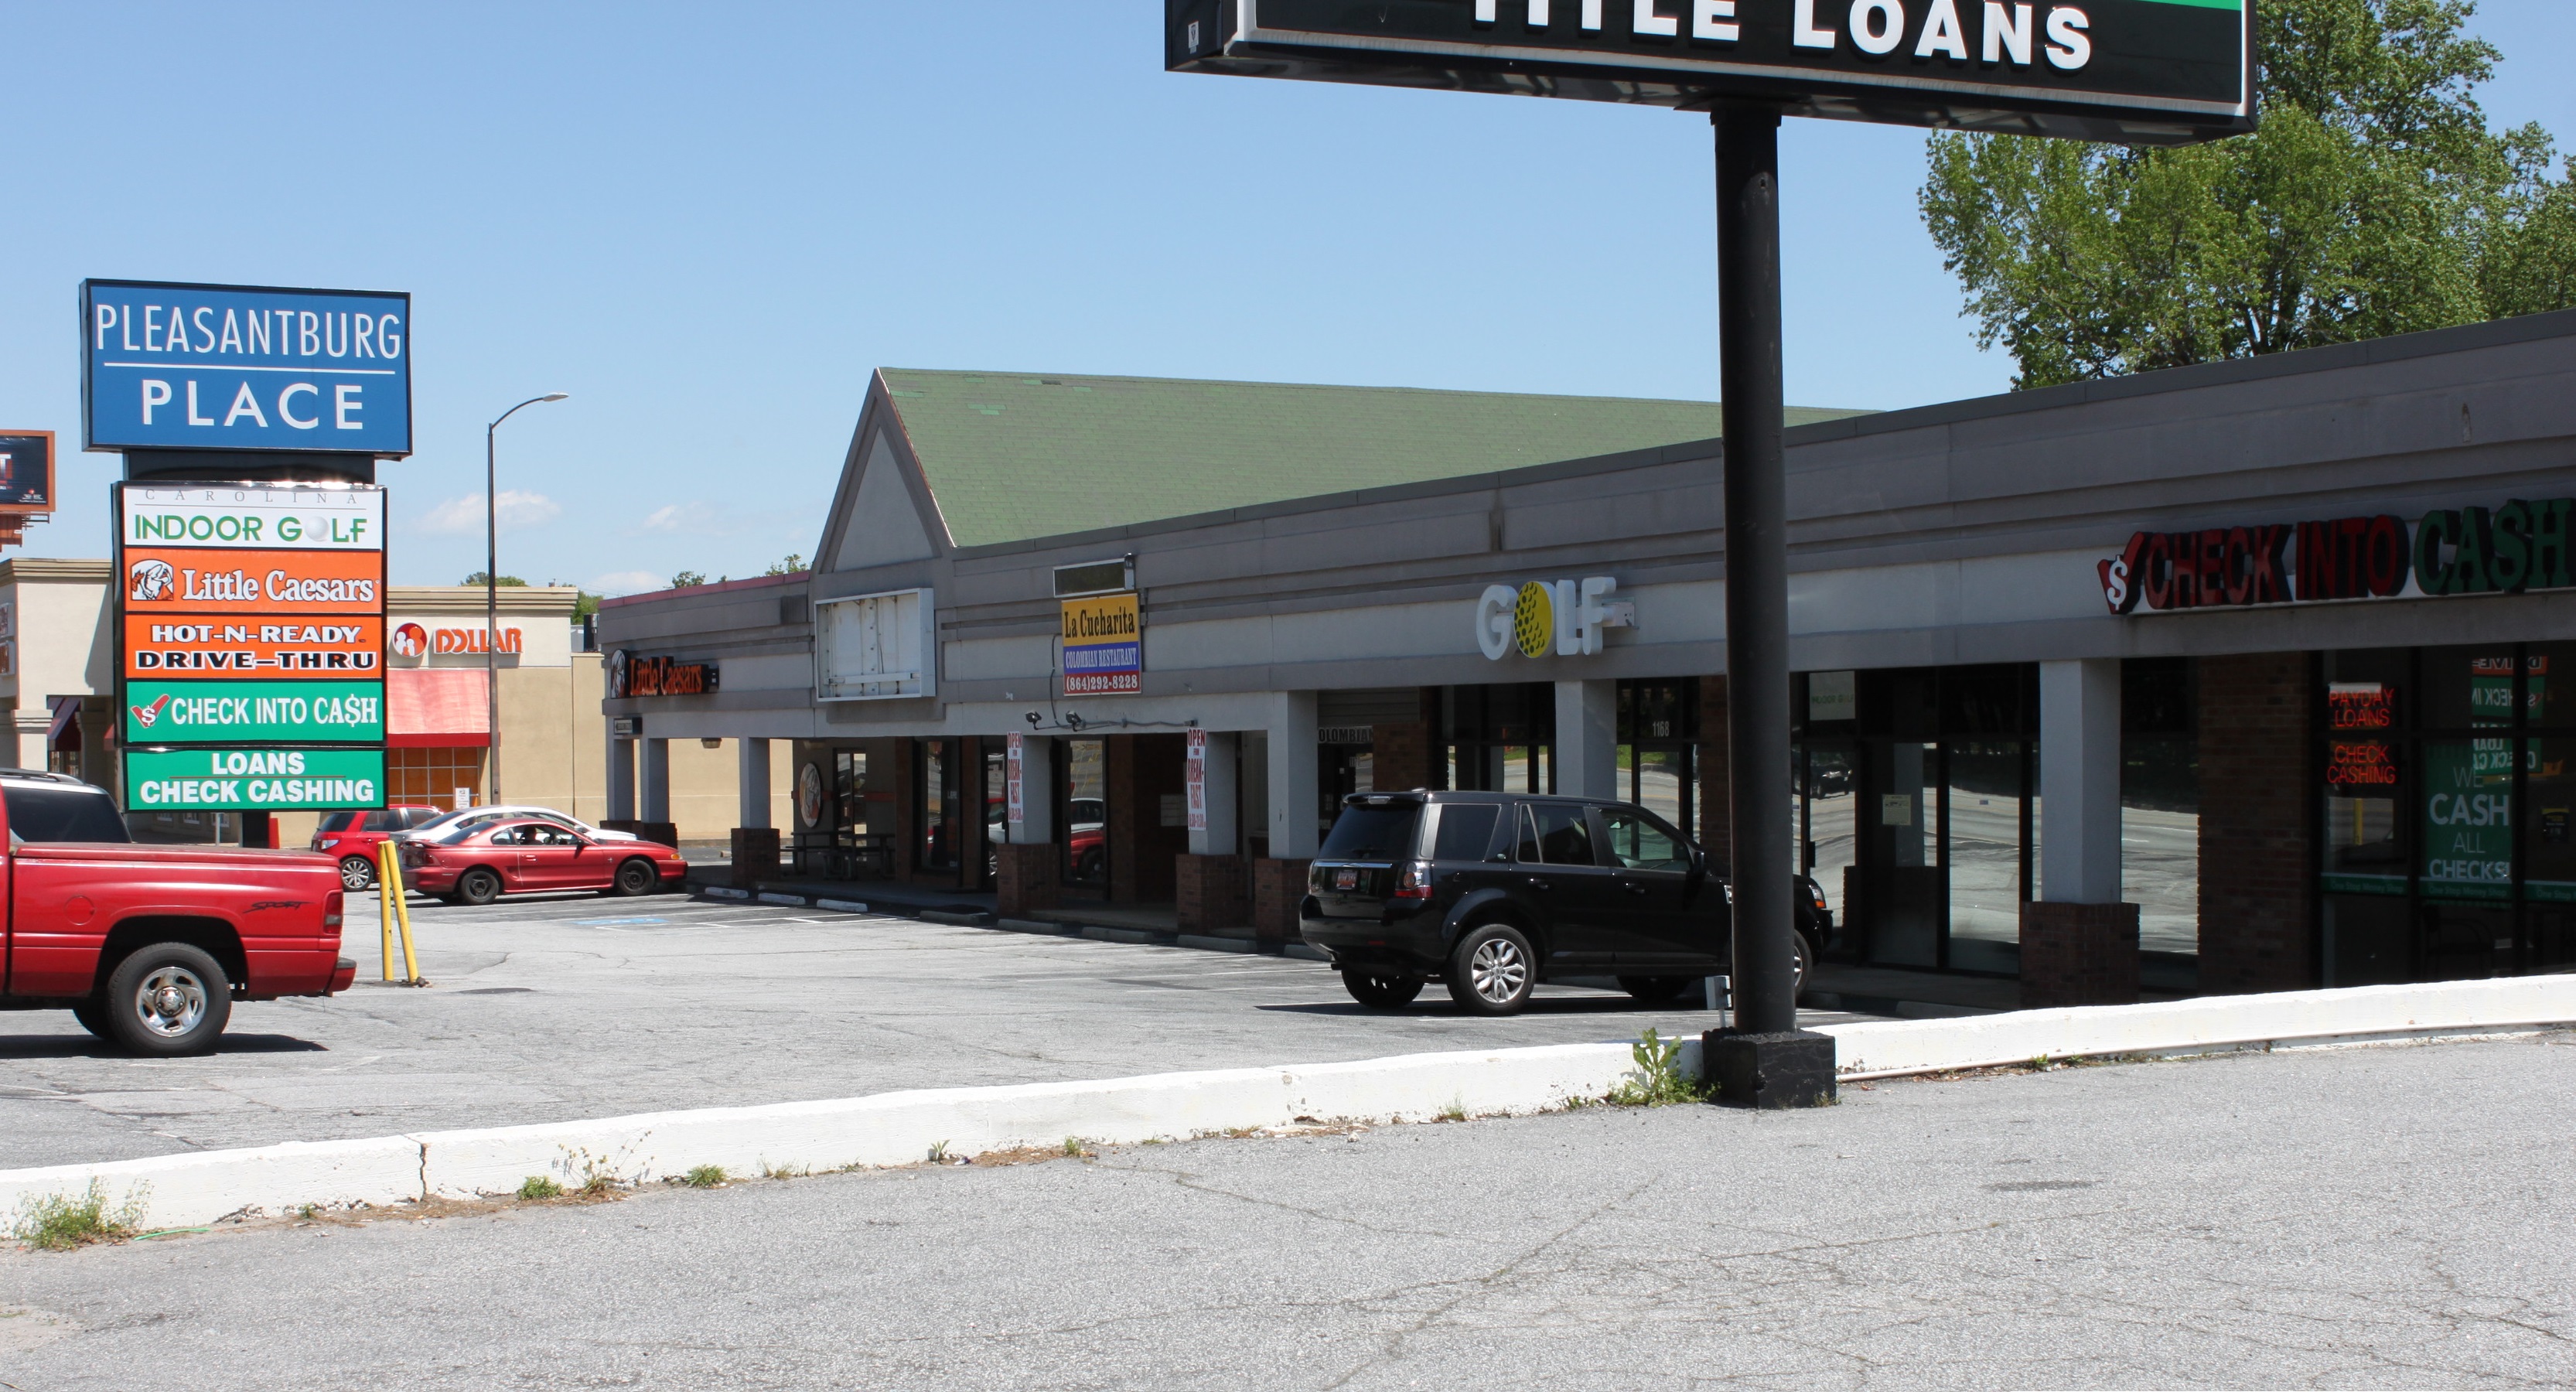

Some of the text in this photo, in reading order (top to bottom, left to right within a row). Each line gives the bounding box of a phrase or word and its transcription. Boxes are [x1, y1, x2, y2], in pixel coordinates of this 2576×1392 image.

[1793, 0, 2091, 70] LOANS
[97, 303, 401, 359] PLEASANTBURG
[142, 379, 363, 429] PLACE
[145, 489, 357, 504] CAROLINA
[135, 514, 263, 542] INDOOR
[2145, 520, 2285, 609] CHECK
[2295, 514, 2399, 601] INTO
[182, 569, 374, 602] Little Caesars
[1065, 606, 1134, 638] La Cucharita
[1476, 577, 1617, 660] GOLF
[151, 624, 361, 643] HOT-N-READY
[434, 627, 523, 654] DOLLAR
[135, 650, 377, 670] DRIVE-THRU
[1066, 647, 1136, 668] COLOMBIAN RESTAURANT
[630, 656, 702, 695] Little Caesars
[1066, 674, 1138, 691] (864)292-8228
[2329, 687, 2395, 707] PAYDAY
[171, 698, 248, 725] CHECK
[257, 698, 306, 725] INTO
[2335, 708, 2390, 727] LOANS
[1008, 732, 1022, 748] OPEN
[1188, 729, 1206, 746] OPEN
[1319, 728, 1373, 742] OLOMBIAN
[1653, 721, 1670, 737] 1168
[212, 753, 305, 775] LOANS
[2335, 745, 2390, 763] CHECK
[2327, 765, 2396, 783] CASHING
[2453, 766, 2484, 788] WE
[141, 780, 374, 803] CHECK CASHING
[2429, 793, 2509, 826] CASH
[2452, 832, 2486, 853] ALL
